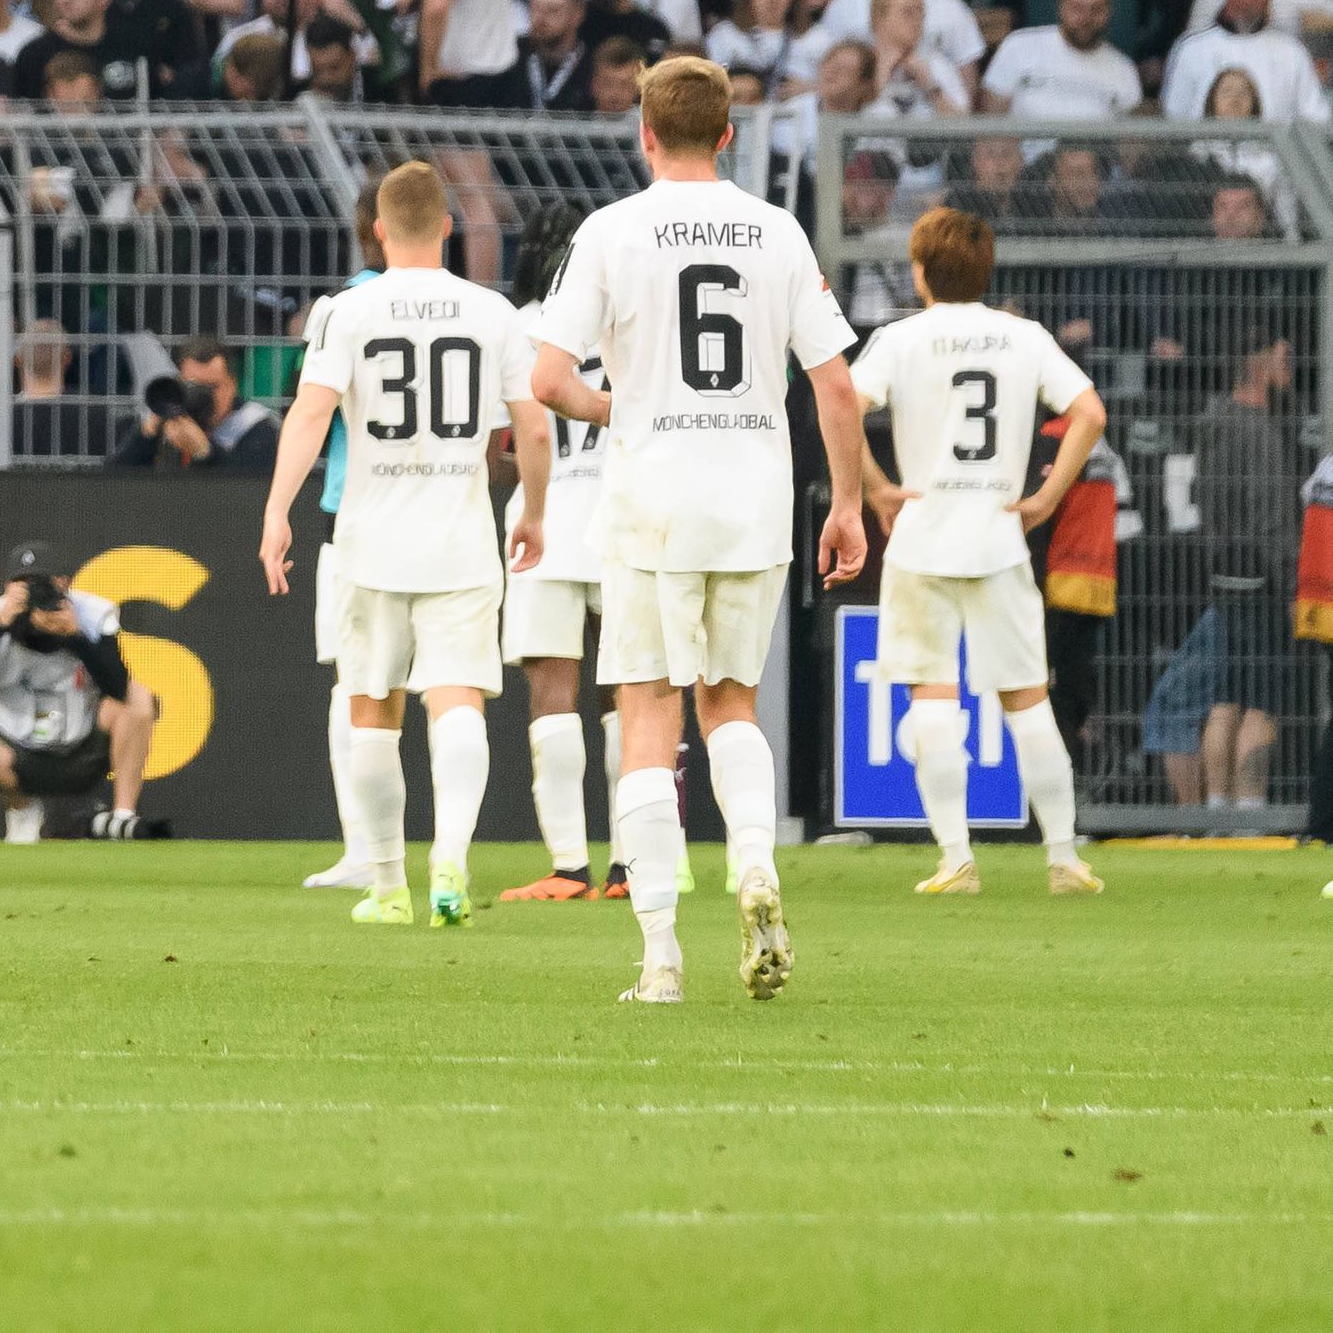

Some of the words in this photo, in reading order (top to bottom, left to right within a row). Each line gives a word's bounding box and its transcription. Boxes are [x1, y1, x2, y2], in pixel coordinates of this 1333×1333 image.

[653, 222, 763, 249] KRAMER
[389, 300, 461, 319] ELVEDI
[678, 264, 746, 394] 6
[363, 336, 482, 439] 30
[952, 370, 997, 461] 3
